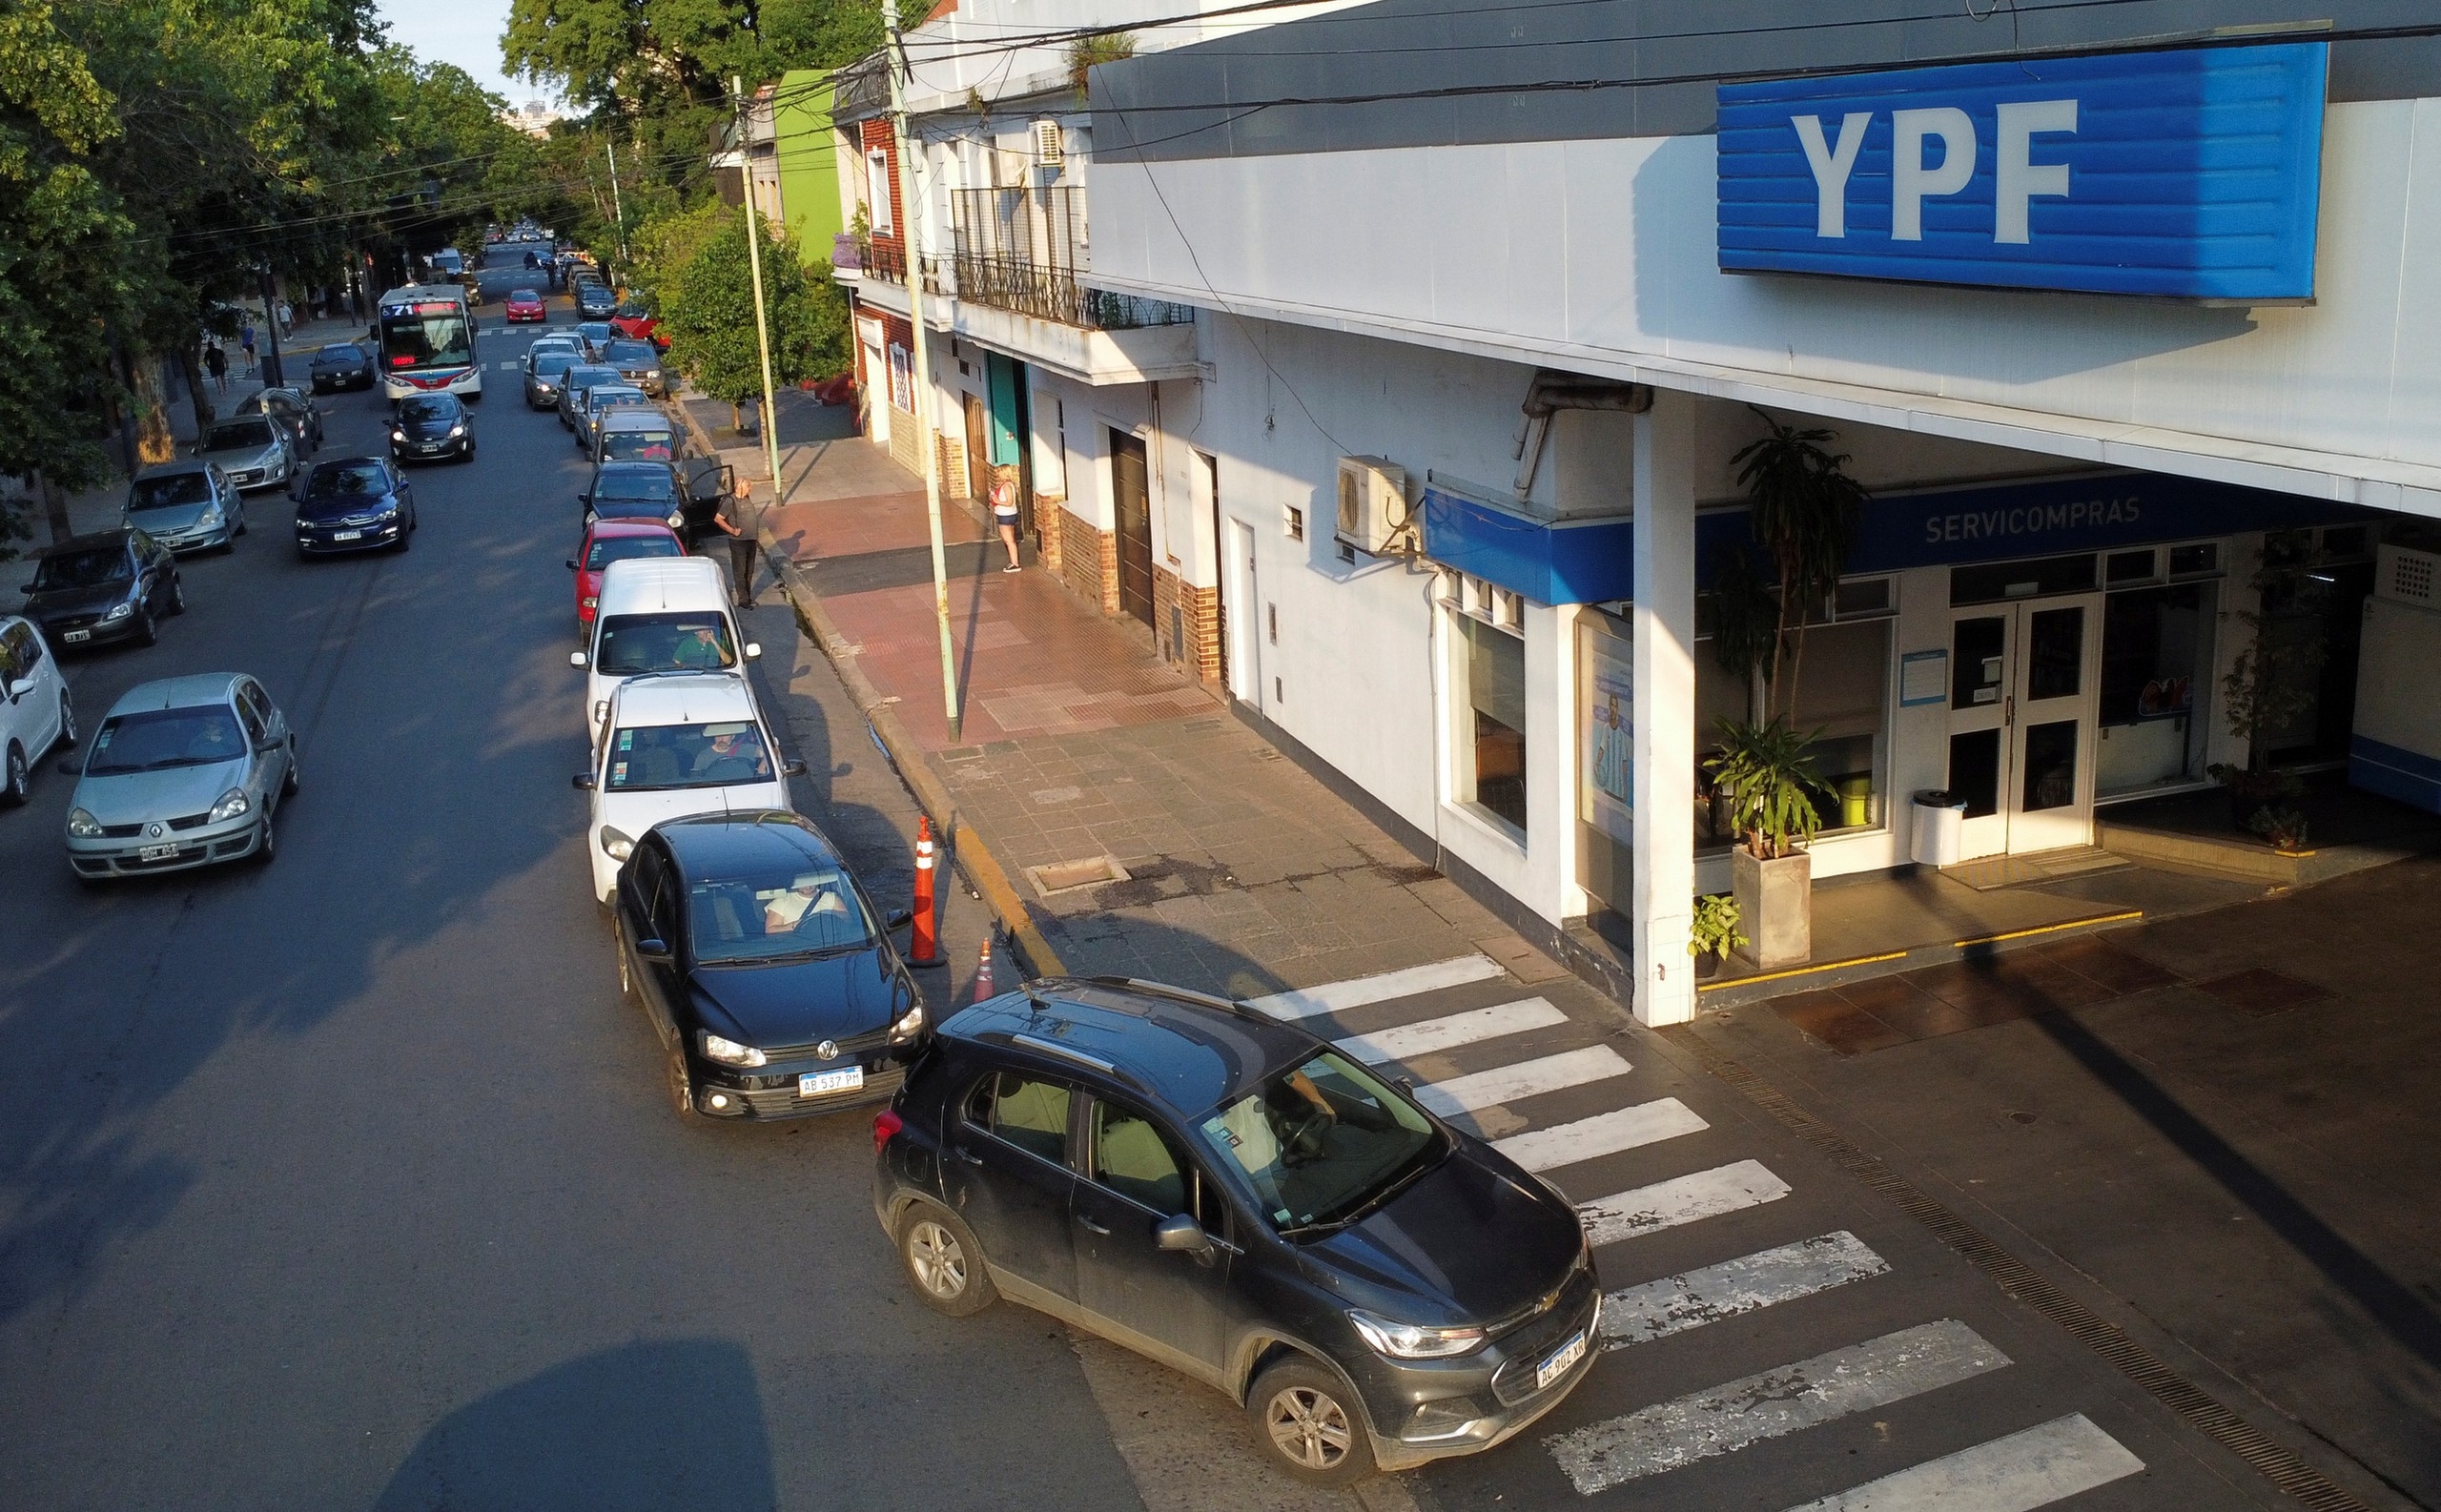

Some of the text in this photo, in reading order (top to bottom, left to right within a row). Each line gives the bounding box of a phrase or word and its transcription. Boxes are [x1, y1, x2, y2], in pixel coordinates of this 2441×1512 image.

[1790, 99, 2078, 244] YPF
[392, 304, 413, 317] 71
[1925, 496, 2141, 543] SERVICOMPRAS
[804, 1073, 861, 1093] AB 537 PM
[1542, 1338, 1585, 1385] AC 902 XR
